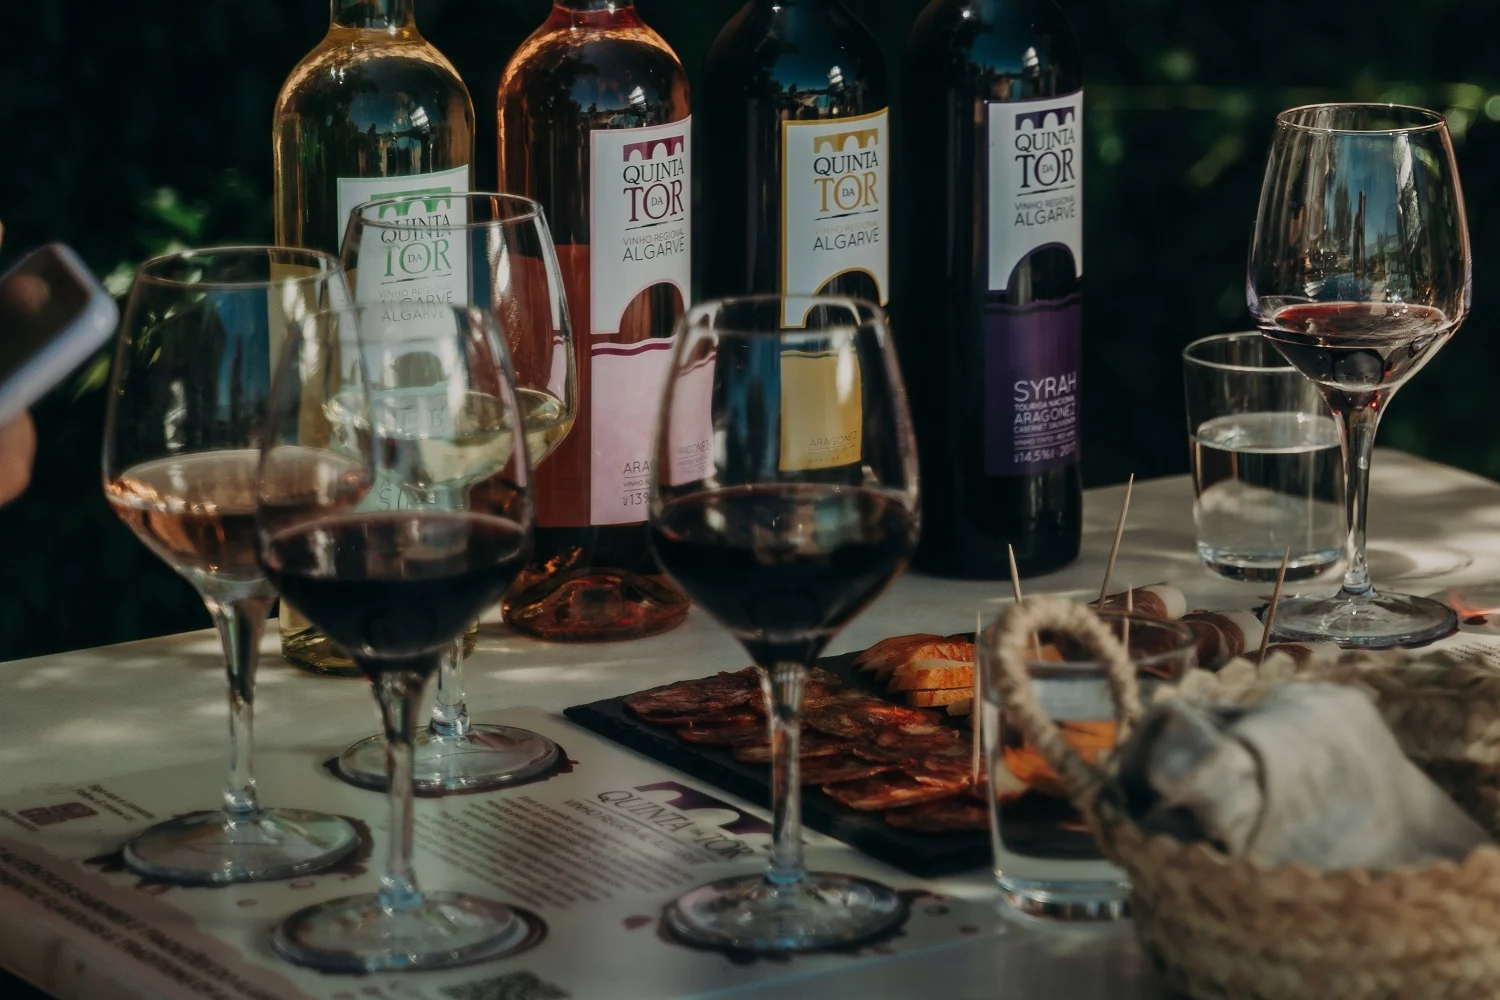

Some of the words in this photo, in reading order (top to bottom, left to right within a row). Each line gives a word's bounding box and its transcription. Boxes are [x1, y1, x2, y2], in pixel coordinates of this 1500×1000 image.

[1015, 128, 1076, 153] QUINTA
[623, 157, 685, 185] QUINTA
[814, 150, 880, 176] QUINTA
[1042, 163, 1055, 174] DA
[651, 196, 664, 207] DA
[842, 187, 856, 198] DA
[1014, 203, 1076, 227] ALGARVE
[380, 213, 453, 244] QUINTA
[623, 234, 652, 245] VINHO
[813, 226, 880, 251] ALGARVE
[407, 253, 424, 263] DA
[622, 236, 685, 262] ALGARVE
[1014, 371, 1077, 403] SYRAH
[1013, 402, 1076, 425] ARAGONEZ
[809, 430, 858, 448] ARAGONEZ
[623, 479, 645, 488] VINHO
[597, 790, 696, 833] QUINTA
